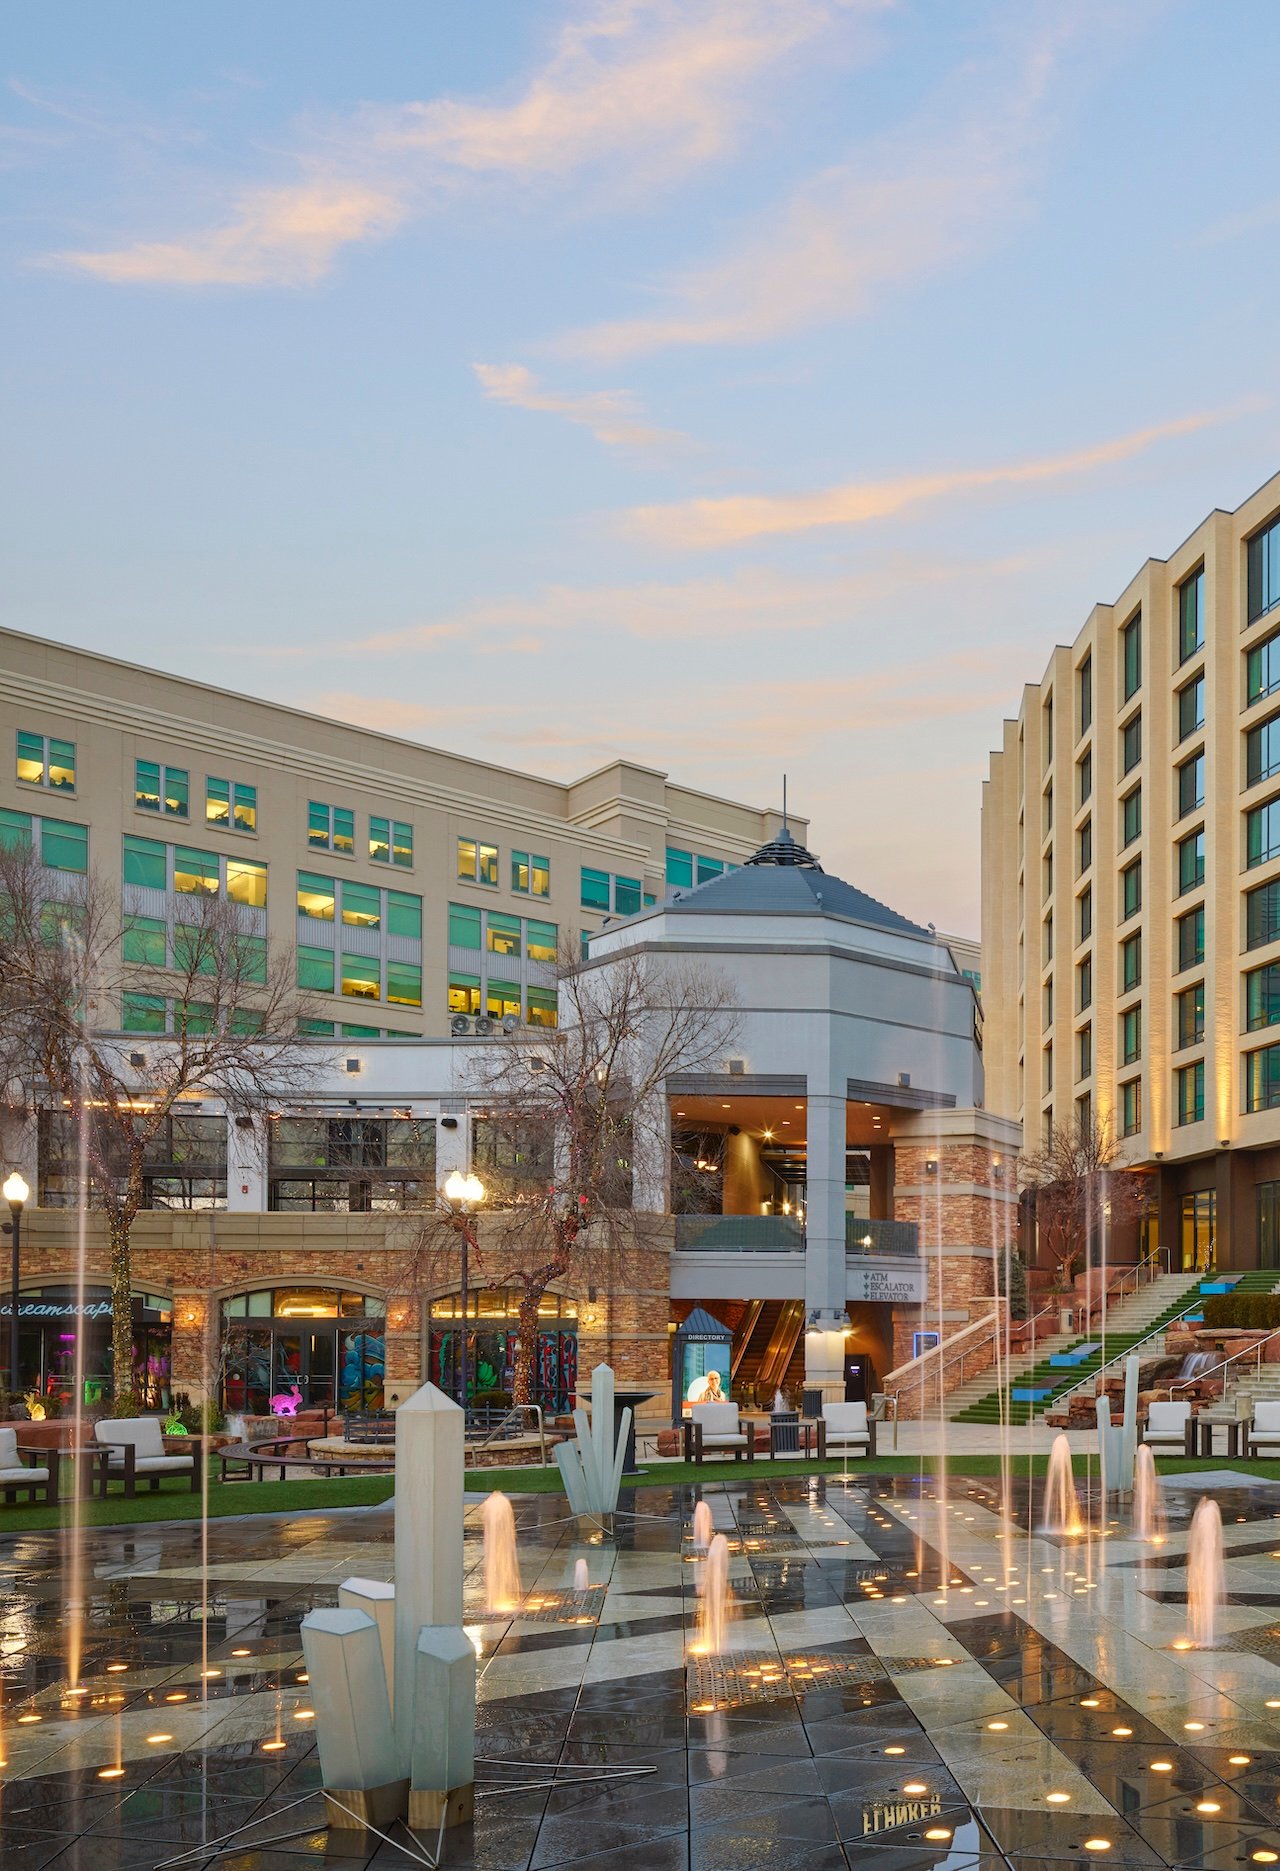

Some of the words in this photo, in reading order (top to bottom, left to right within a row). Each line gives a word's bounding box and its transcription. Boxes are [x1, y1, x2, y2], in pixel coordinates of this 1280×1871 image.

[870, 1273, 889, 1281] ATM
[870, 1282, 915, 1292] ESCALATOR
[870, 1291, 909, 1301] ELEVATOR
